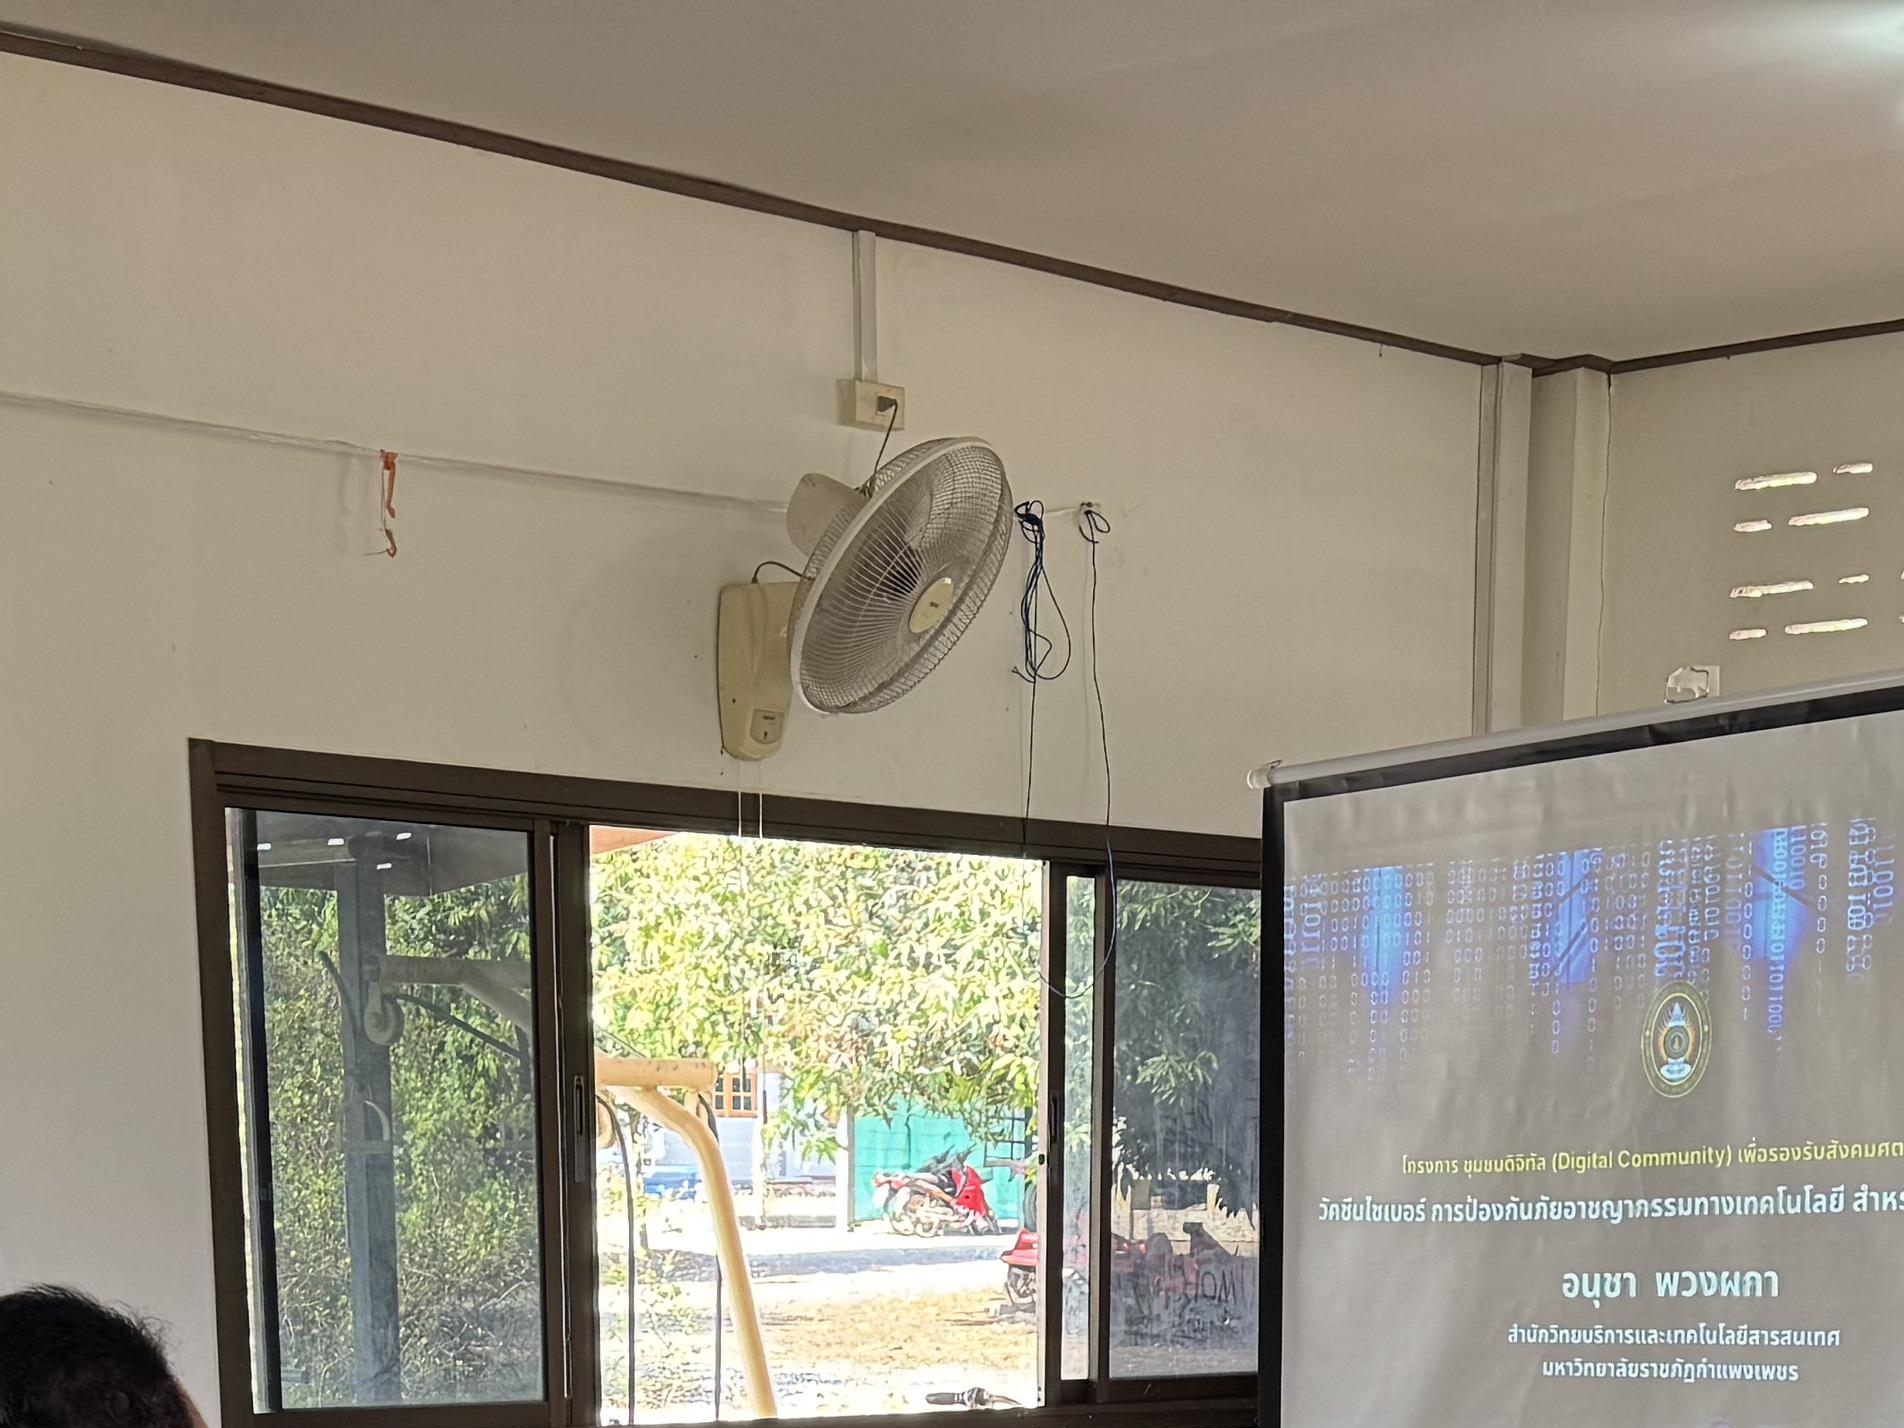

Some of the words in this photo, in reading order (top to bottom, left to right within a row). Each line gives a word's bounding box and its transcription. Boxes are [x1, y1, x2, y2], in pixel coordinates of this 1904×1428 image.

[1402, 1153, 1459, 1175] โครงการ
[1463, 1154, 1546, 1179] ชุมชนดิจิทัล
[1552, 1149, 1613, 1174] (Digital
[1618, 1144, 1732, 1169] Community)
[1318, 1194, 1426, 1223] วัคซีนไซเบอร์
[1431, 1183, 1846, 1224] การป้องกันภัยอาชญากรรมทางเทคโนโลยี
[1562, 1270, 1637, 1309] อนุชา
[1655, 1269, 1780, 1298] พวงผกา
[1507, 1322, 1841, 1347] สำนักวิทยบริการและเทคโนโลยีสารสนเทศ
[1542, 1357, 1799, 1384] มหาวิทยาลัยราชภัฏกำแพงเพชร
